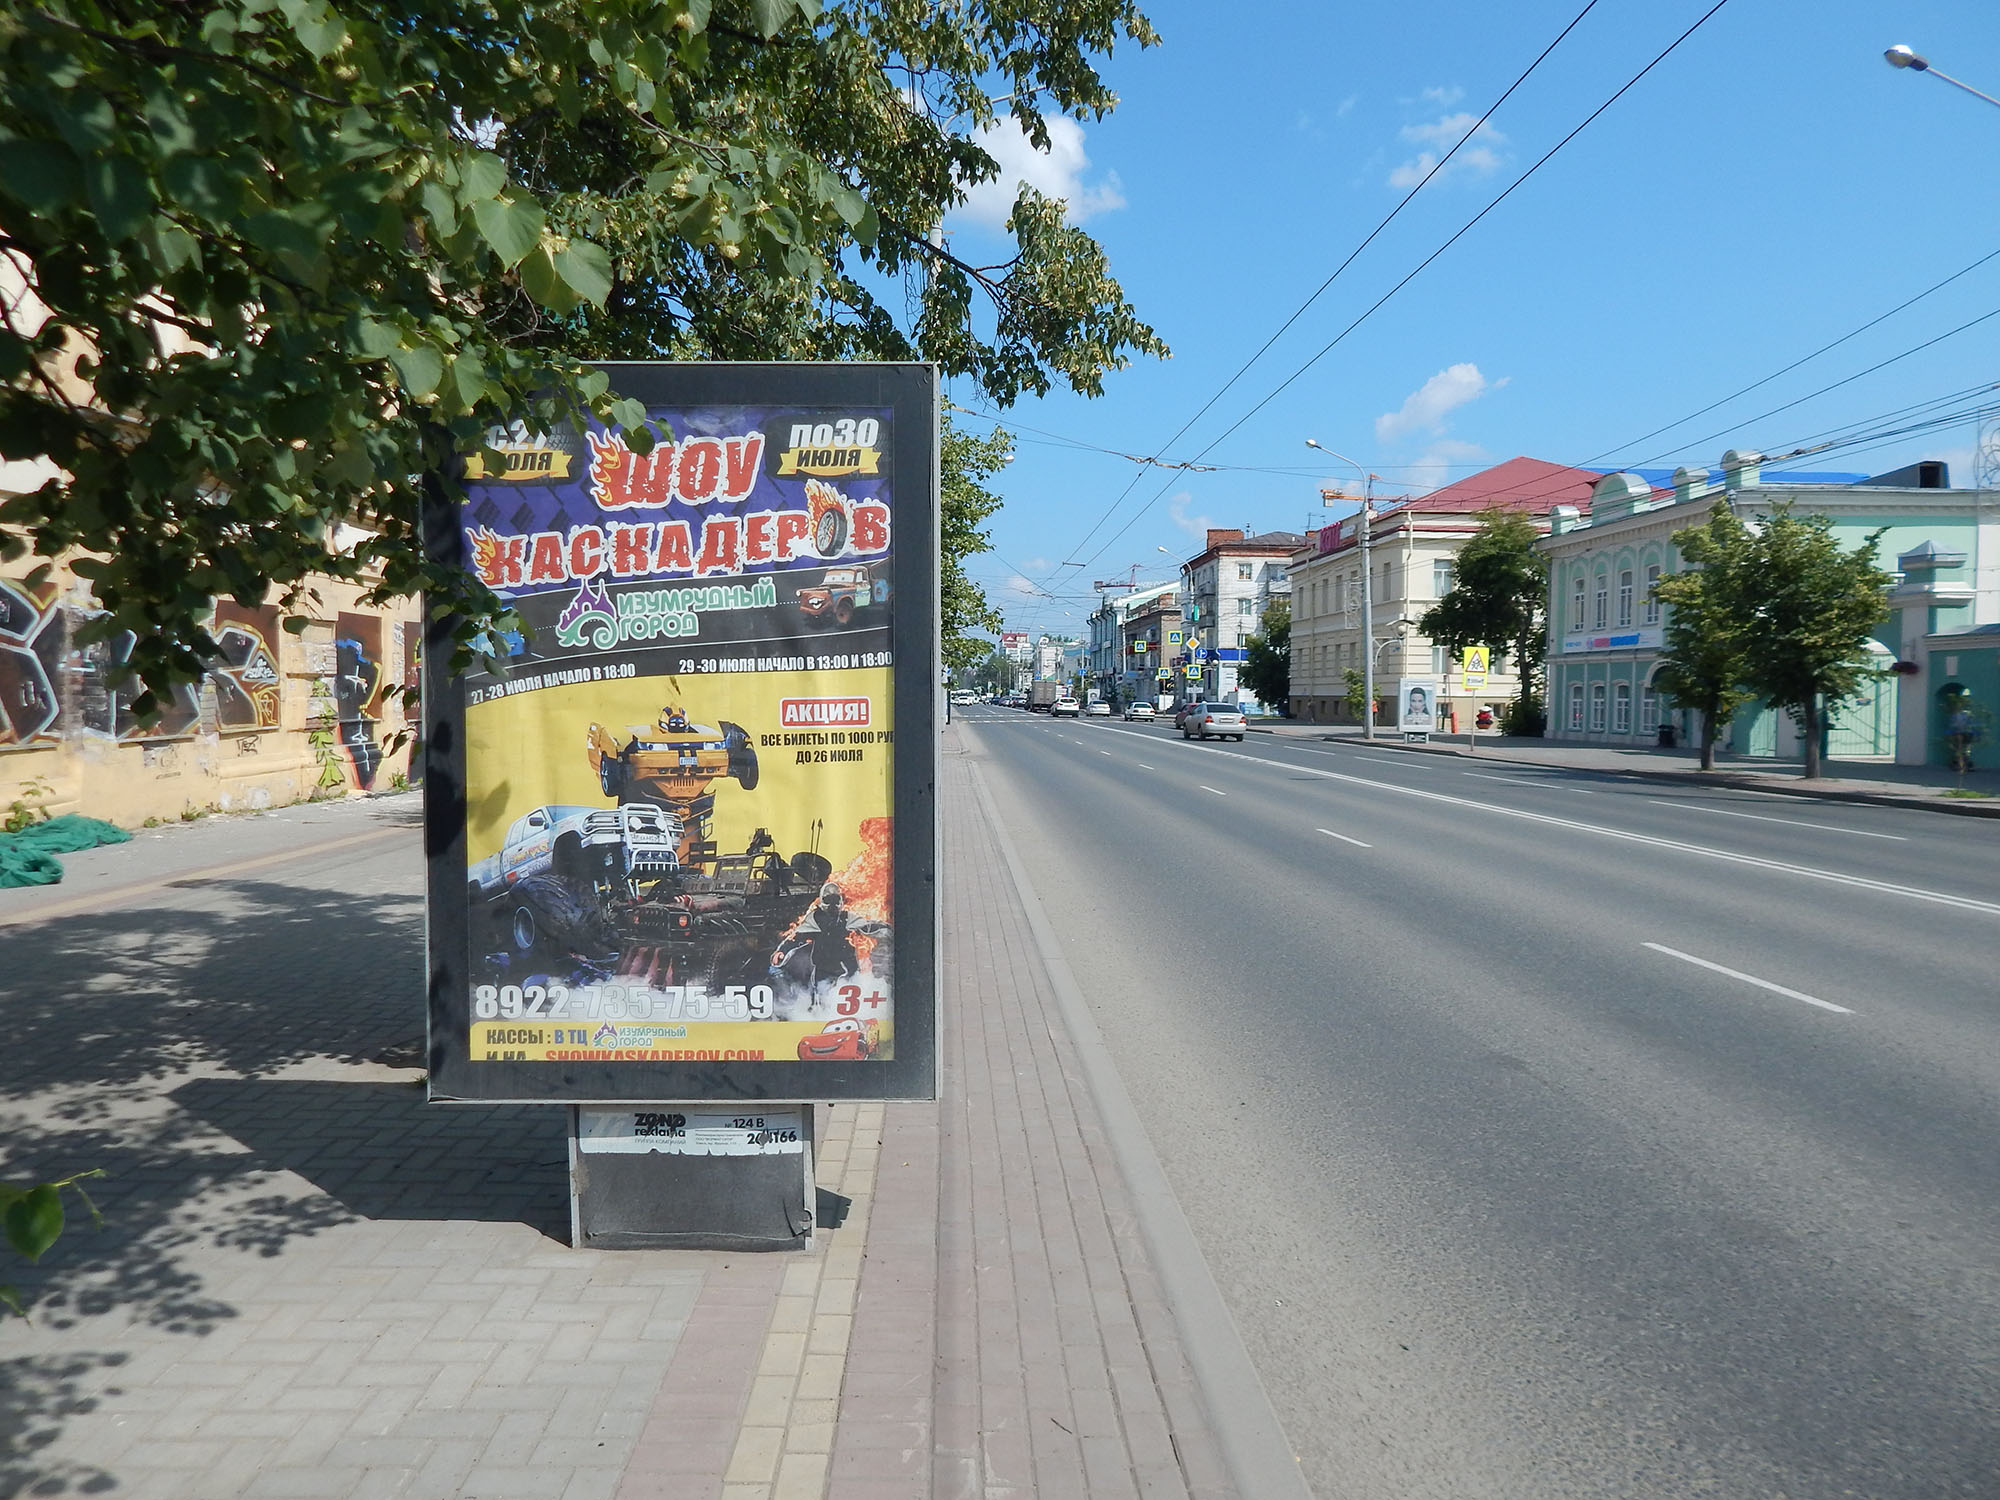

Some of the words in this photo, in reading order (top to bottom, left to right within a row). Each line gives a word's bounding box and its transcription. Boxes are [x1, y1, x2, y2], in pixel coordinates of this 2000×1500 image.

[796, 449, 861, 467] ИЮЛЯ
[617, 577, 777, 615] ИЗУМРУДНЫЙ
[619, 613, 699, 641] ГОРОД
[719, 658, 755, 673] ИЮЛЯ
[757, 657, 805, 671] НАЧАЛО
[807, 656, 815, 670] В
[817, 654, 849, 669] 13:00
[851, 653, 859, 667] И
[861, 651, 892, 667] 18:00
[506, 677, 541, 694] ИЮЛЯ
[543, 668, 590, 686] НАЧАЛО
[593, 668, 601, 681] В
[603, 663, 635, 679] 18:00
[785, 702, 867, 723] АКЦИЯ!
[761, 735, 782, 746] ВСЕ
[784, 733, 829, 747] БИЛЕТЫ
[831, 732, 845, 745] ПО
[847, 732, 874, 744] 1000
[795, 751, 811, 764] ДО
[814, 750, 828, 763] 26
[830, 749, 863, 762] ИЮЛЯ
[475, 984, 774, 1019] 8922-735-75-59
[836, 985, 887, 1015] 3+
[554, 1029, 564, 1043] В
[568, 1029, 588, 1046] ТЦ
[619, 1026, 686, 1037] ИЗУМРУДНЫЙ
[619, 1037, 652, 1047] ГОРОД
[733, 1117, 754, 1128] 124
